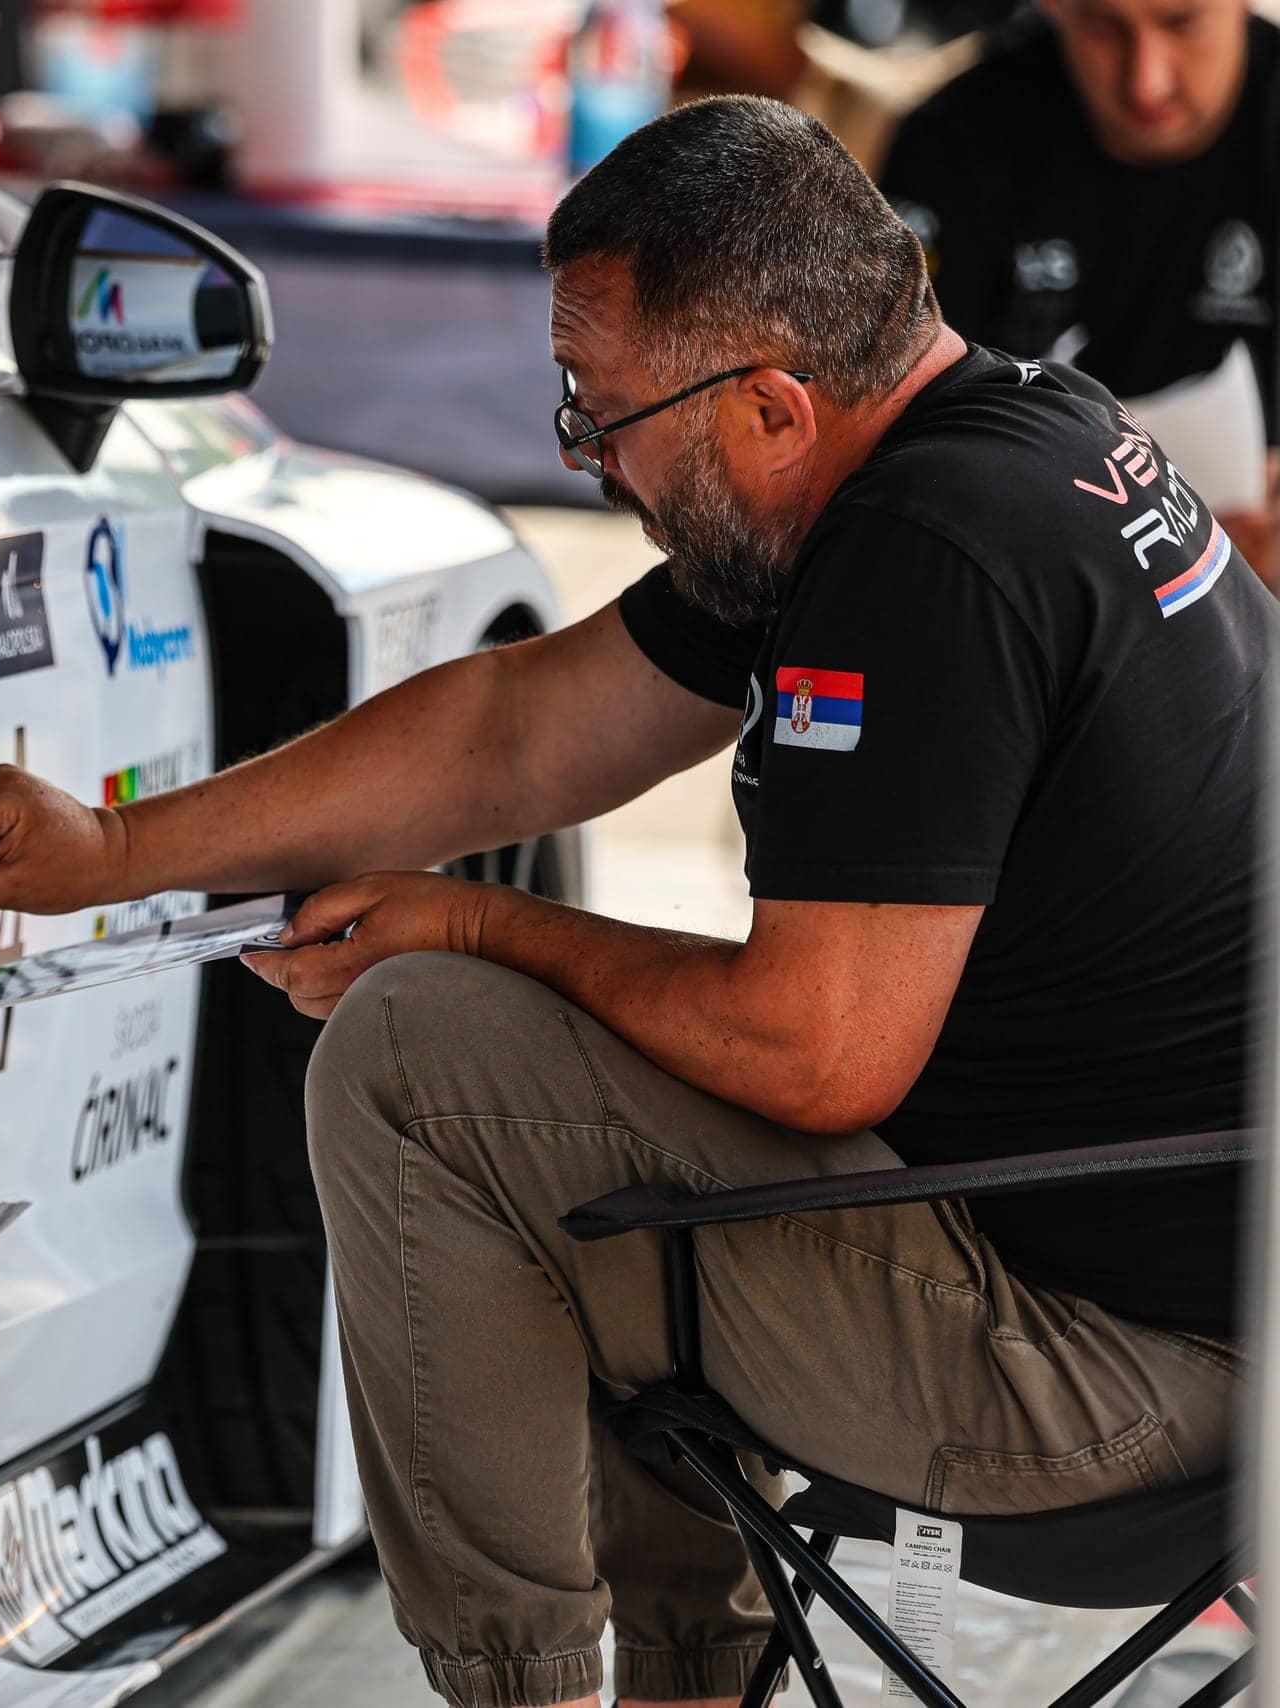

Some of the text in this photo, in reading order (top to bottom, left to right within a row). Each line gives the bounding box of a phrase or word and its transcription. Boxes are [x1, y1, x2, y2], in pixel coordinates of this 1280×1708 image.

[921, 1527, 942, 1537] JYSK
[904, 1542, 933, 1552] CAMPING
[933, 1546, 952, 1554] CHAIR
